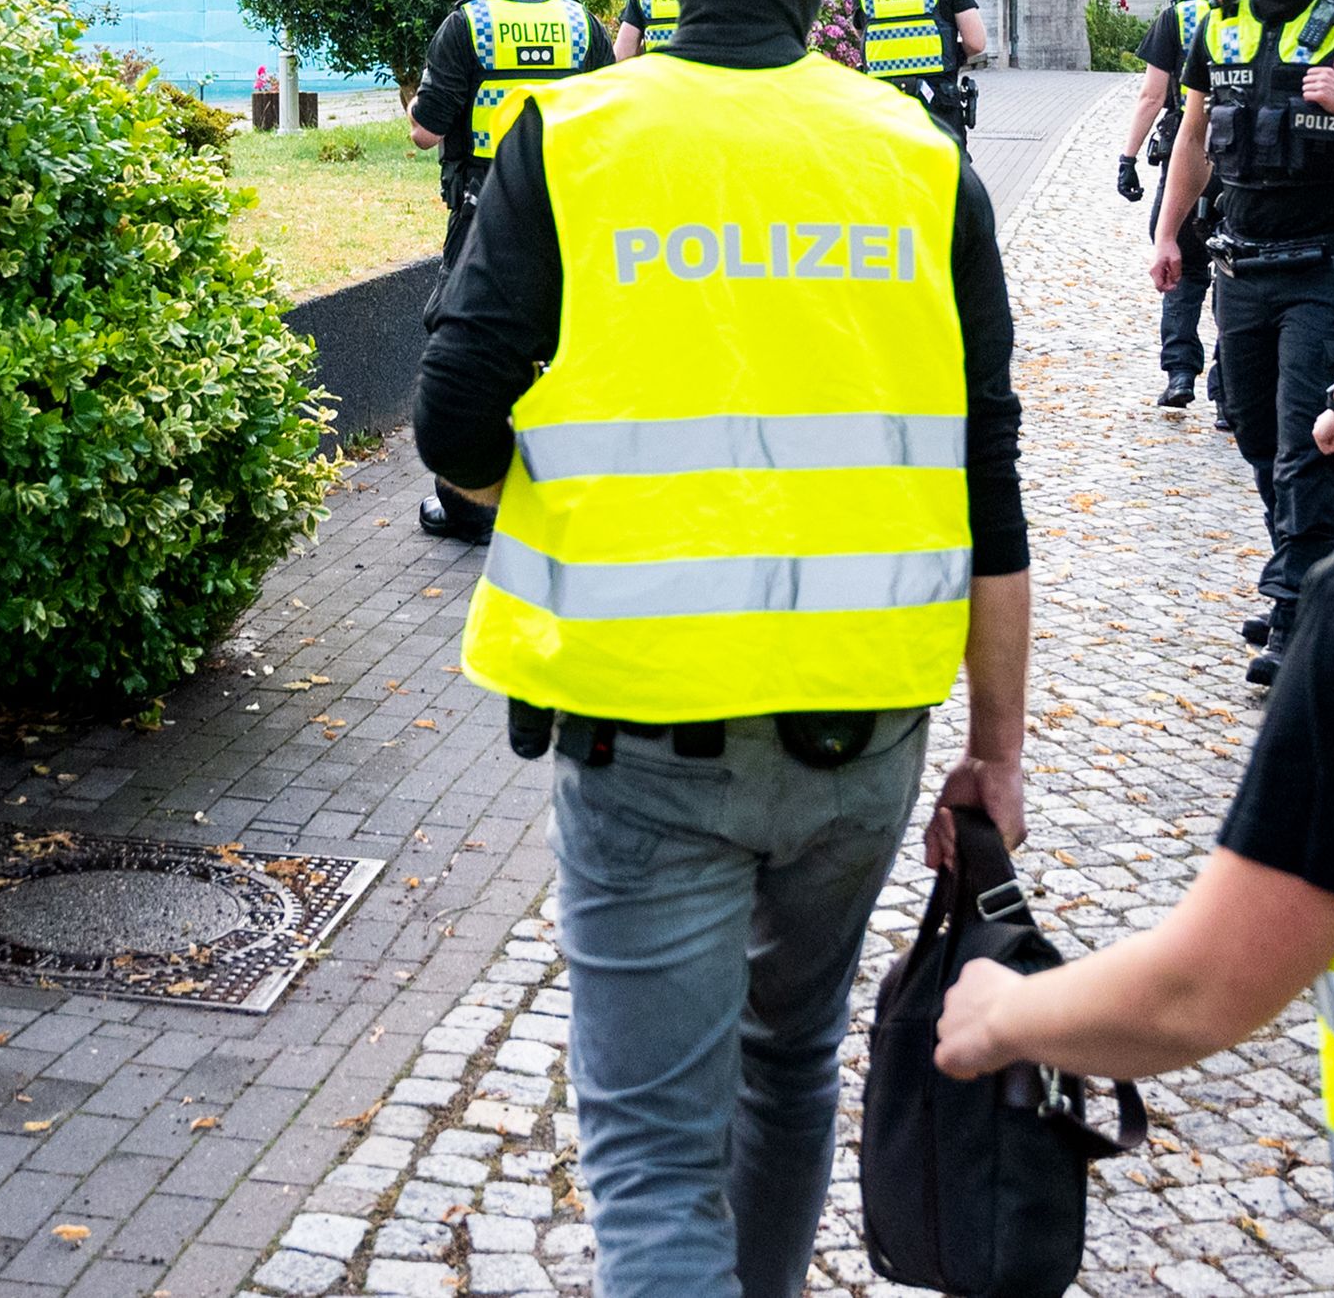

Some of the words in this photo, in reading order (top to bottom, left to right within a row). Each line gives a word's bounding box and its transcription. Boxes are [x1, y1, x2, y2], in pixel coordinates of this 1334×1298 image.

[499, 22, 566, 43] POLIZEI
[1210, 69, 1254, 88] POLIZEI
[614, 223, 915, 283] POLIZEI
